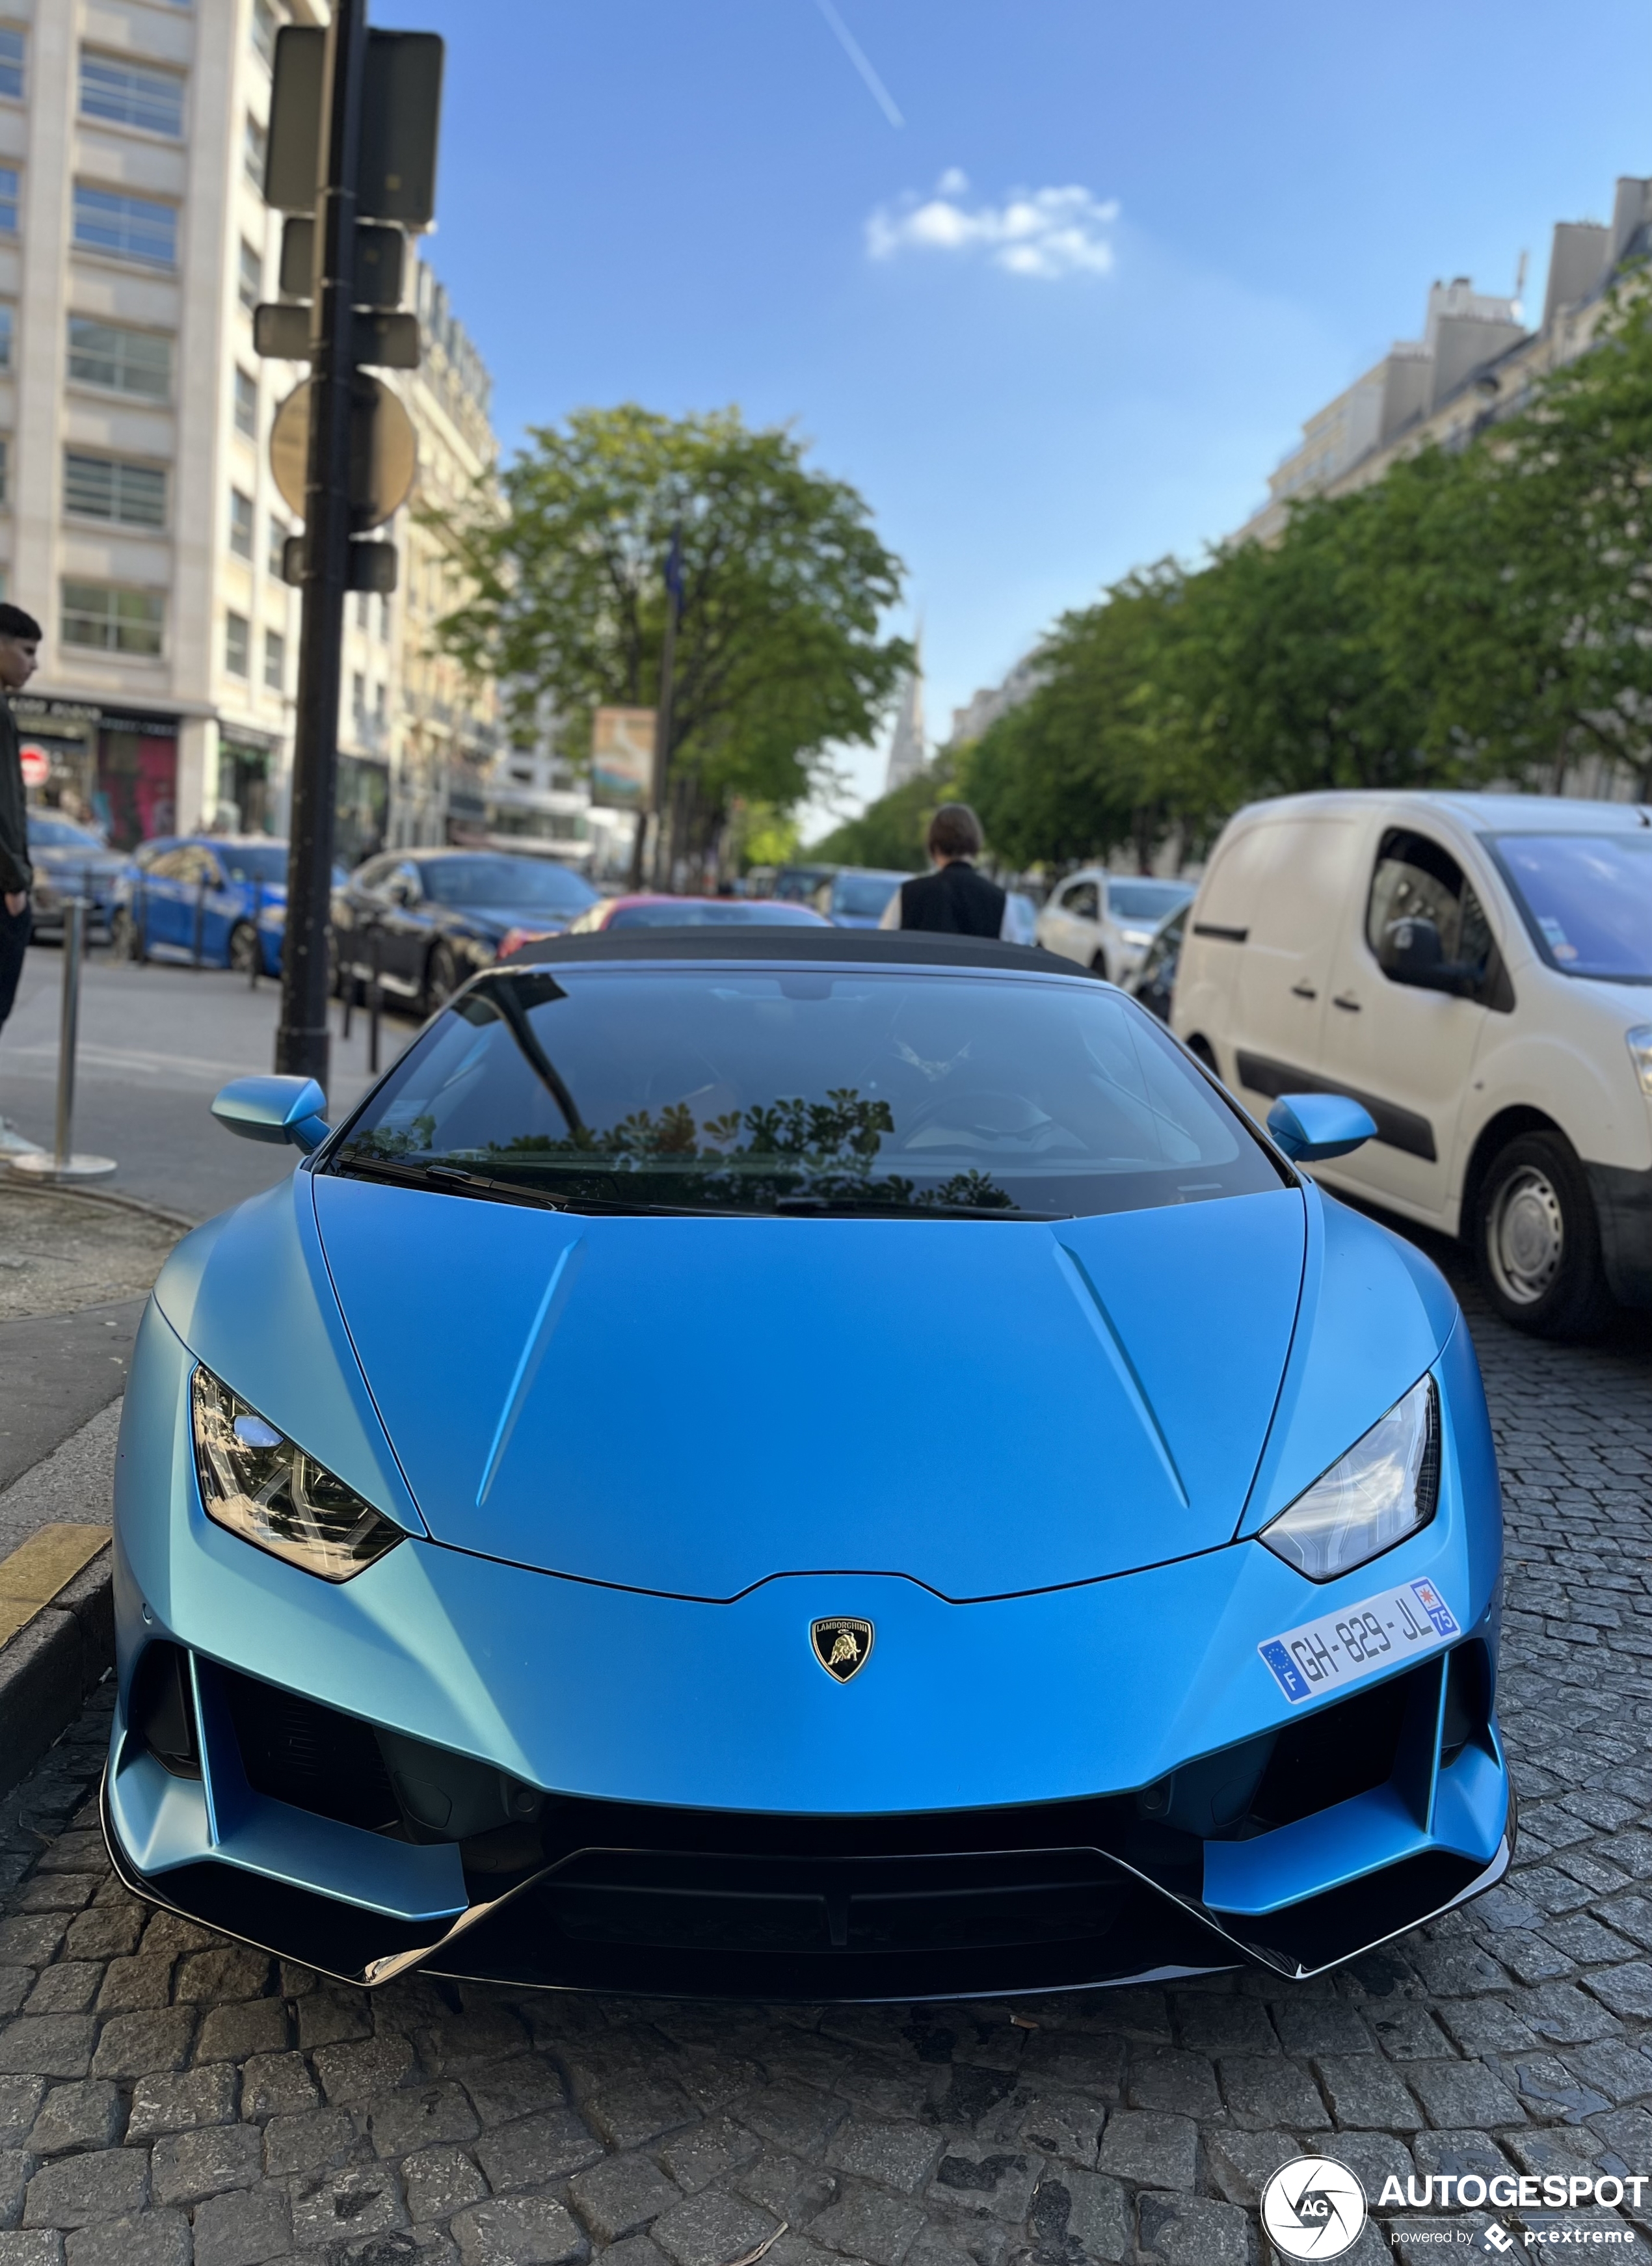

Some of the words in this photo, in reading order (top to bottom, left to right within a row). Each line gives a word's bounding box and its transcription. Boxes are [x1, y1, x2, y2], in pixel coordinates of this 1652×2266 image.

[816, 1621, 867, 1633] LAMBORGHINI
[1431, 1609, 1452, 1631] 75
[1291, 1598, 1433, 1681] GH-829-JL
[1283, 1671, 1296, 1691] F
